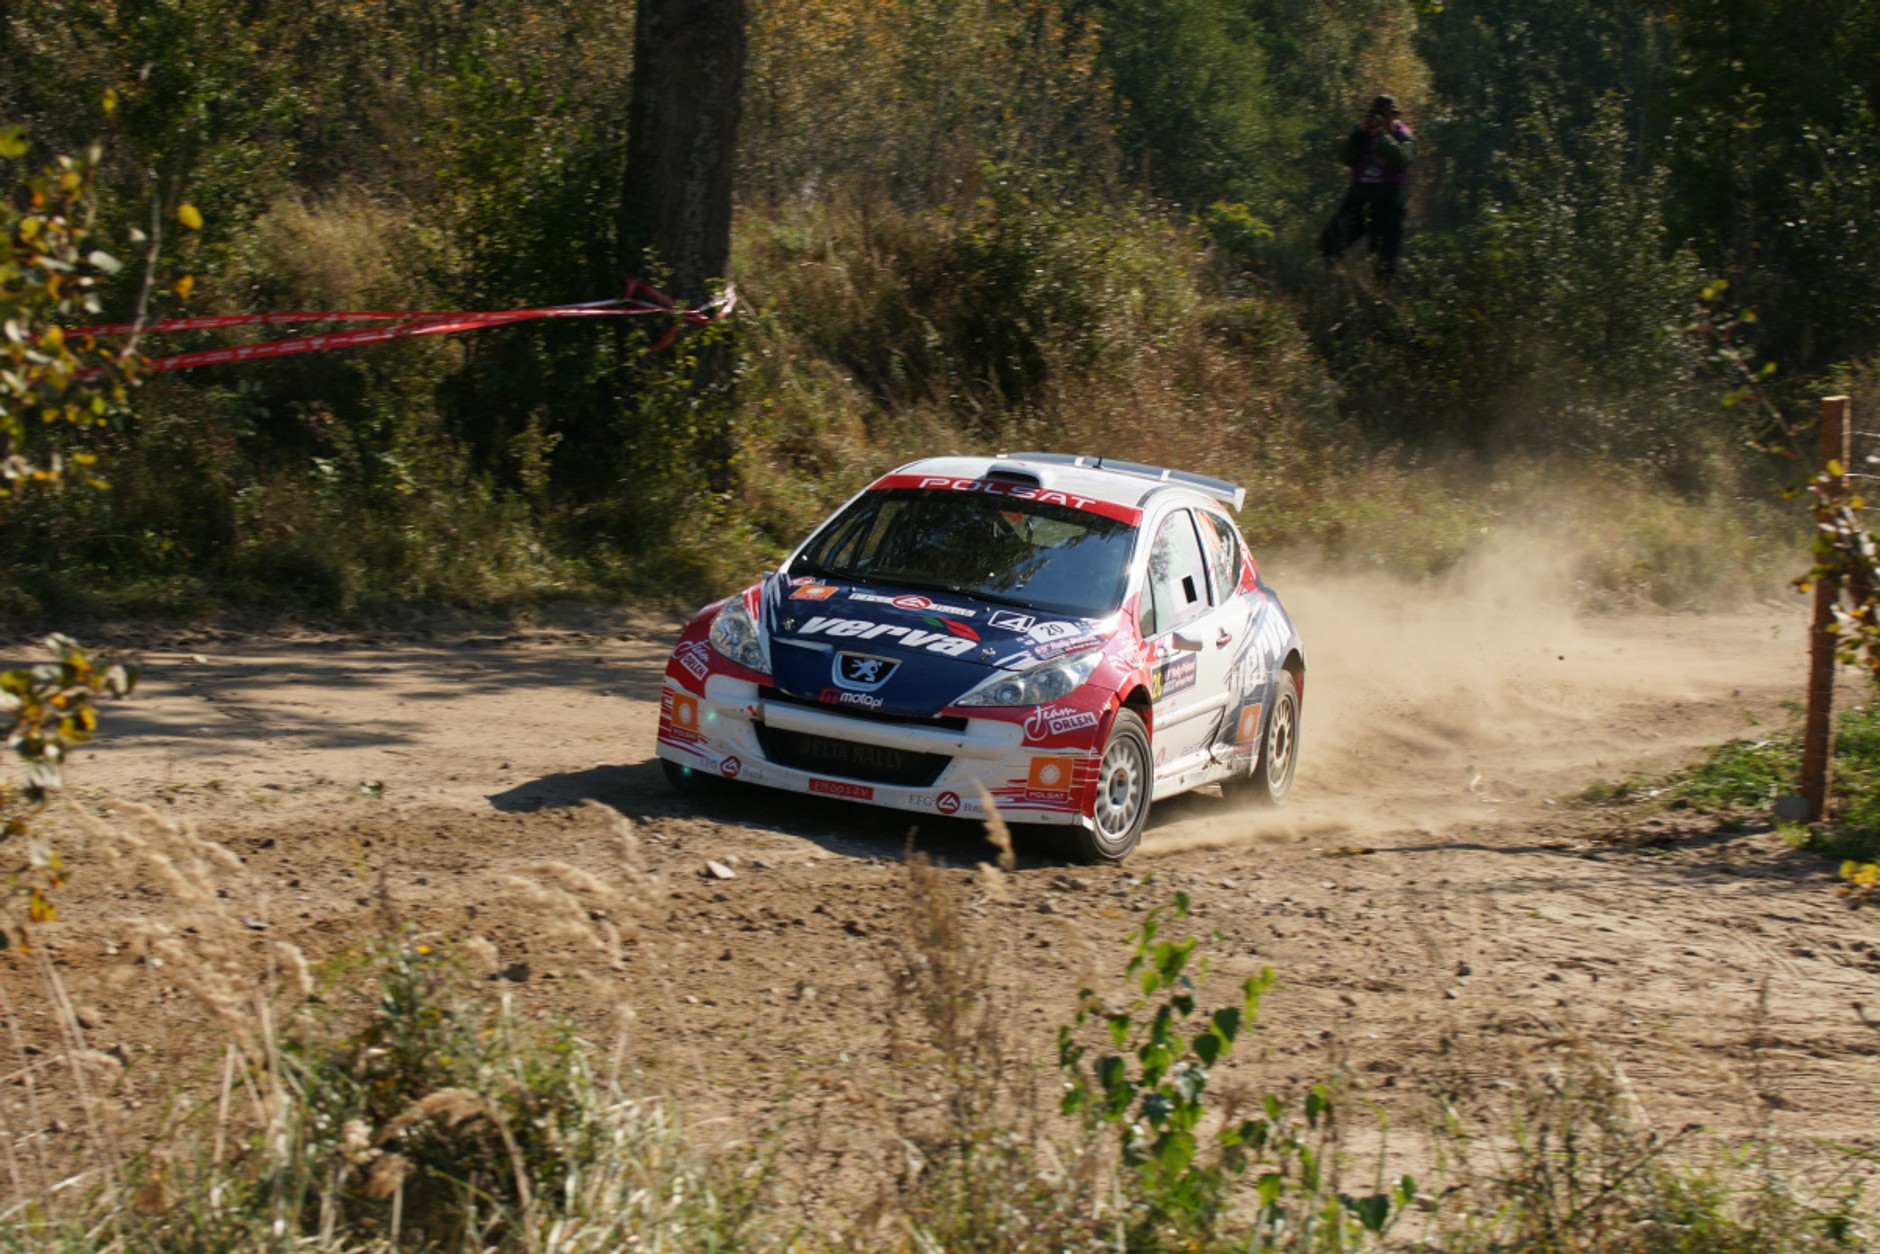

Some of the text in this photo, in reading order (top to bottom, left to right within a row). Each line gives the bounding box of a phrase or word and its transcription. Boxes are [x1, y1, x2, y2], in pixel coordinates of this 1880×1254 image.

[918, 477, 1097, 510] POLSAT
[798, 616, 977, 656] verva
[1040, 623, 1065, 636] 20
[1052, 714, 1094, 731] ORLEN
[908, 795, 934, 807] EFG
[1029, 792, 1065, 800] POLSAT
